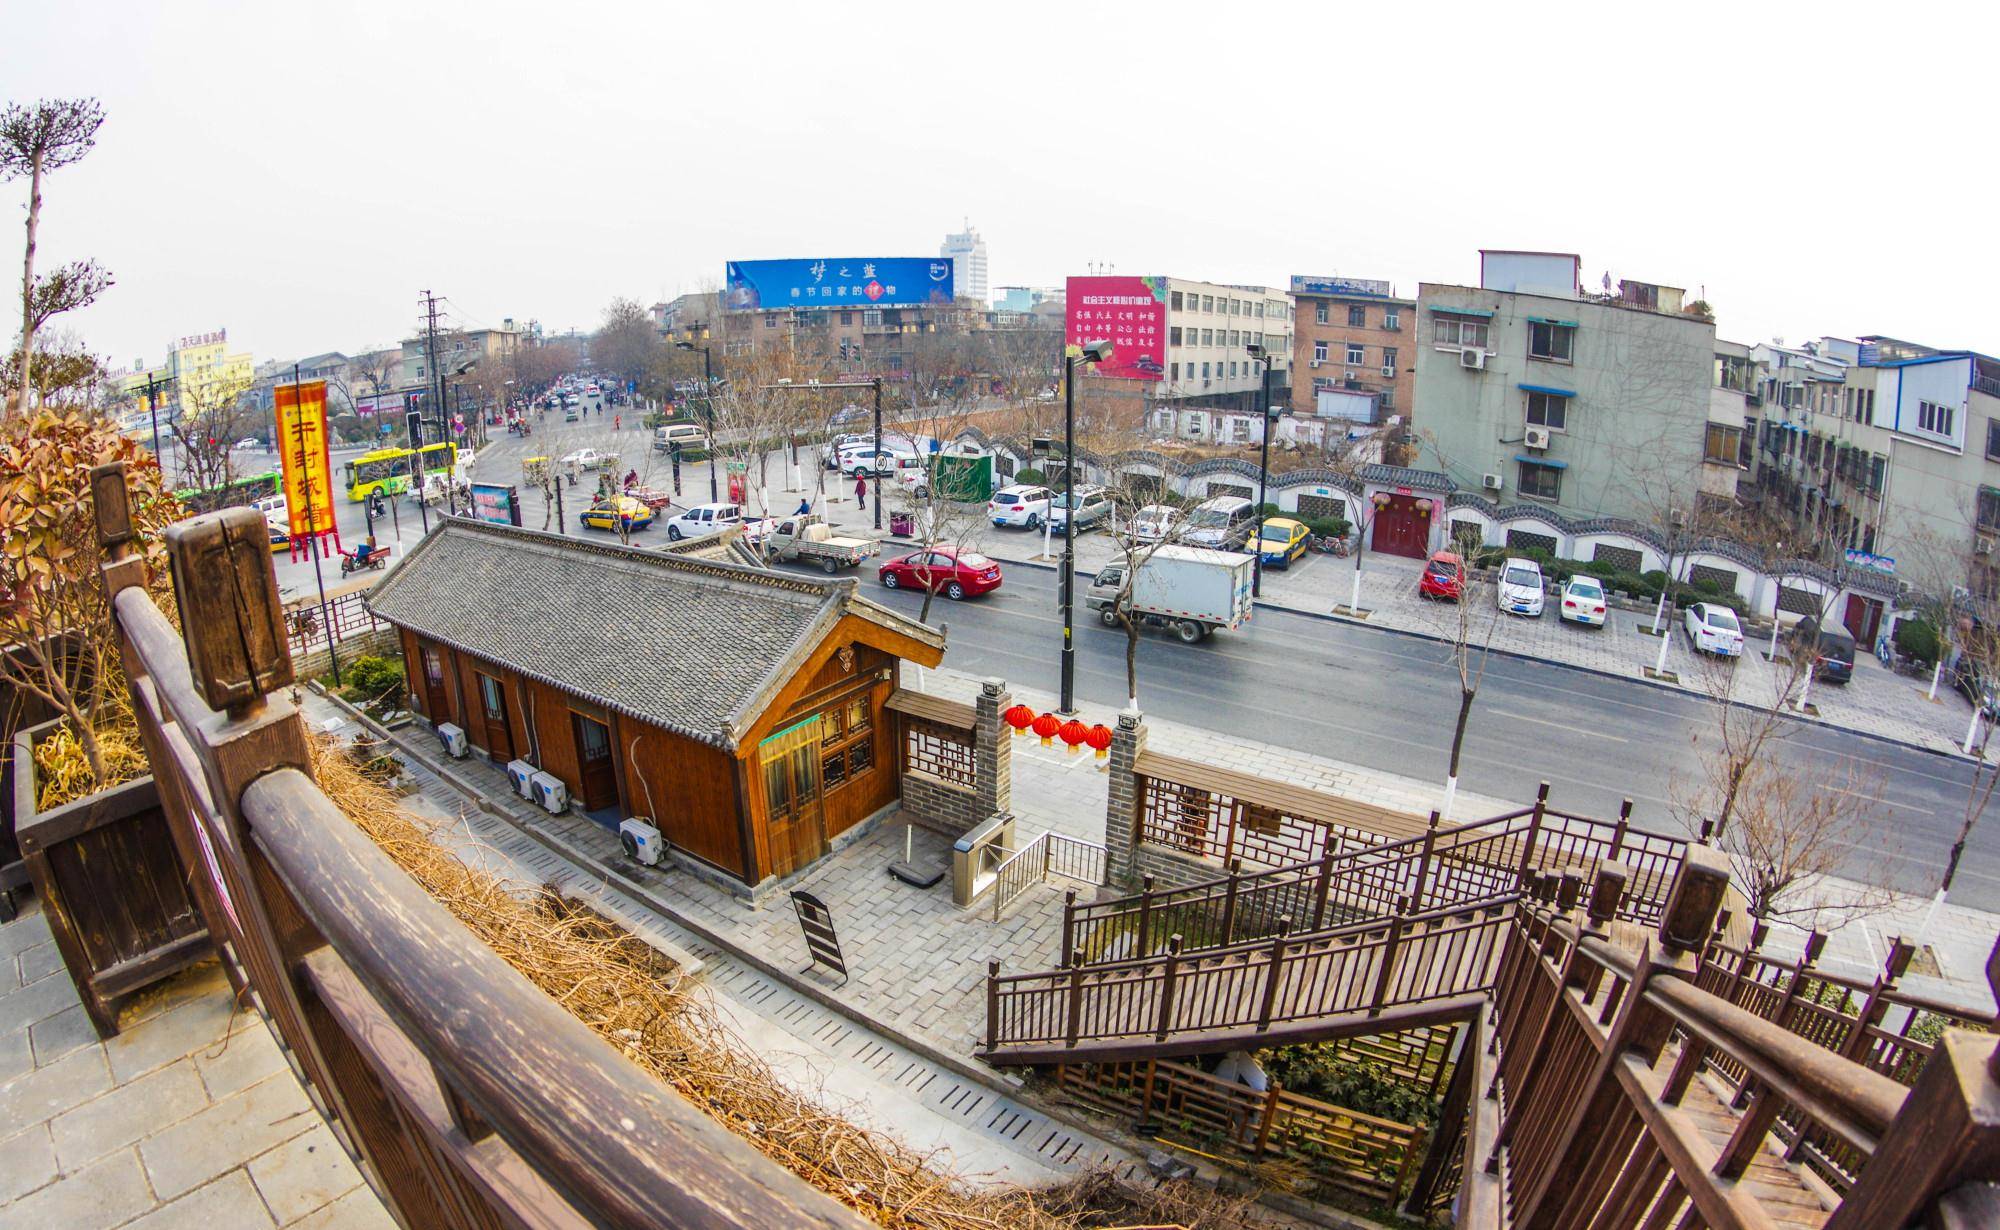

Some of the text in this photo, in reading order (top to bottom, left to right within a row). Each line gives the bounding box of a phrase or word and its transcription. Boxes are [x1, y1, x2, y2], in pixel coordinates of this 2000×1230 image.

[809, 260, 877, 284] 梦之蓝
[1118, 312, 1133, 320] 文明
[1076, 324, 1091, 332] 自由
[291, 421, 322, 524] 开封城墙
